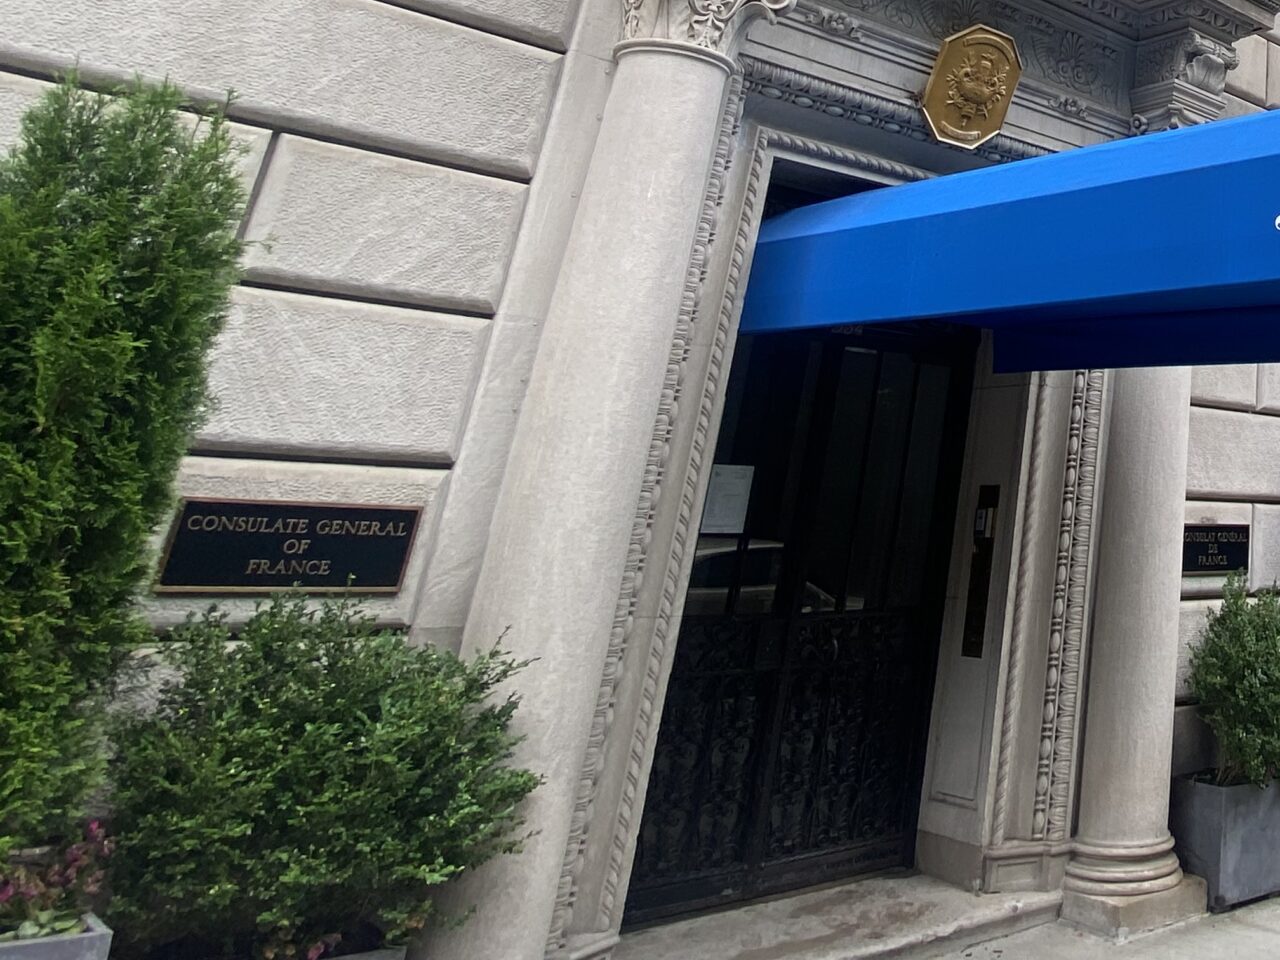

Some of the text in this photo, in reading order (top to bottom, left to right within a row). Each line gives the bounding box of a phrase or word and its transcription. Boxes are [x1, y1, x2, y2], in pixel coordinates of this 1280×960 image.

[187, 515, 407, 537] CONSULATE GENERAL
[283, 539, 311, 554] OF
[1208, 543, 1218, 553] DE
[246, 559, 331, 576] FRANCE
[1198, 555, 1228, 565] FRANCE
